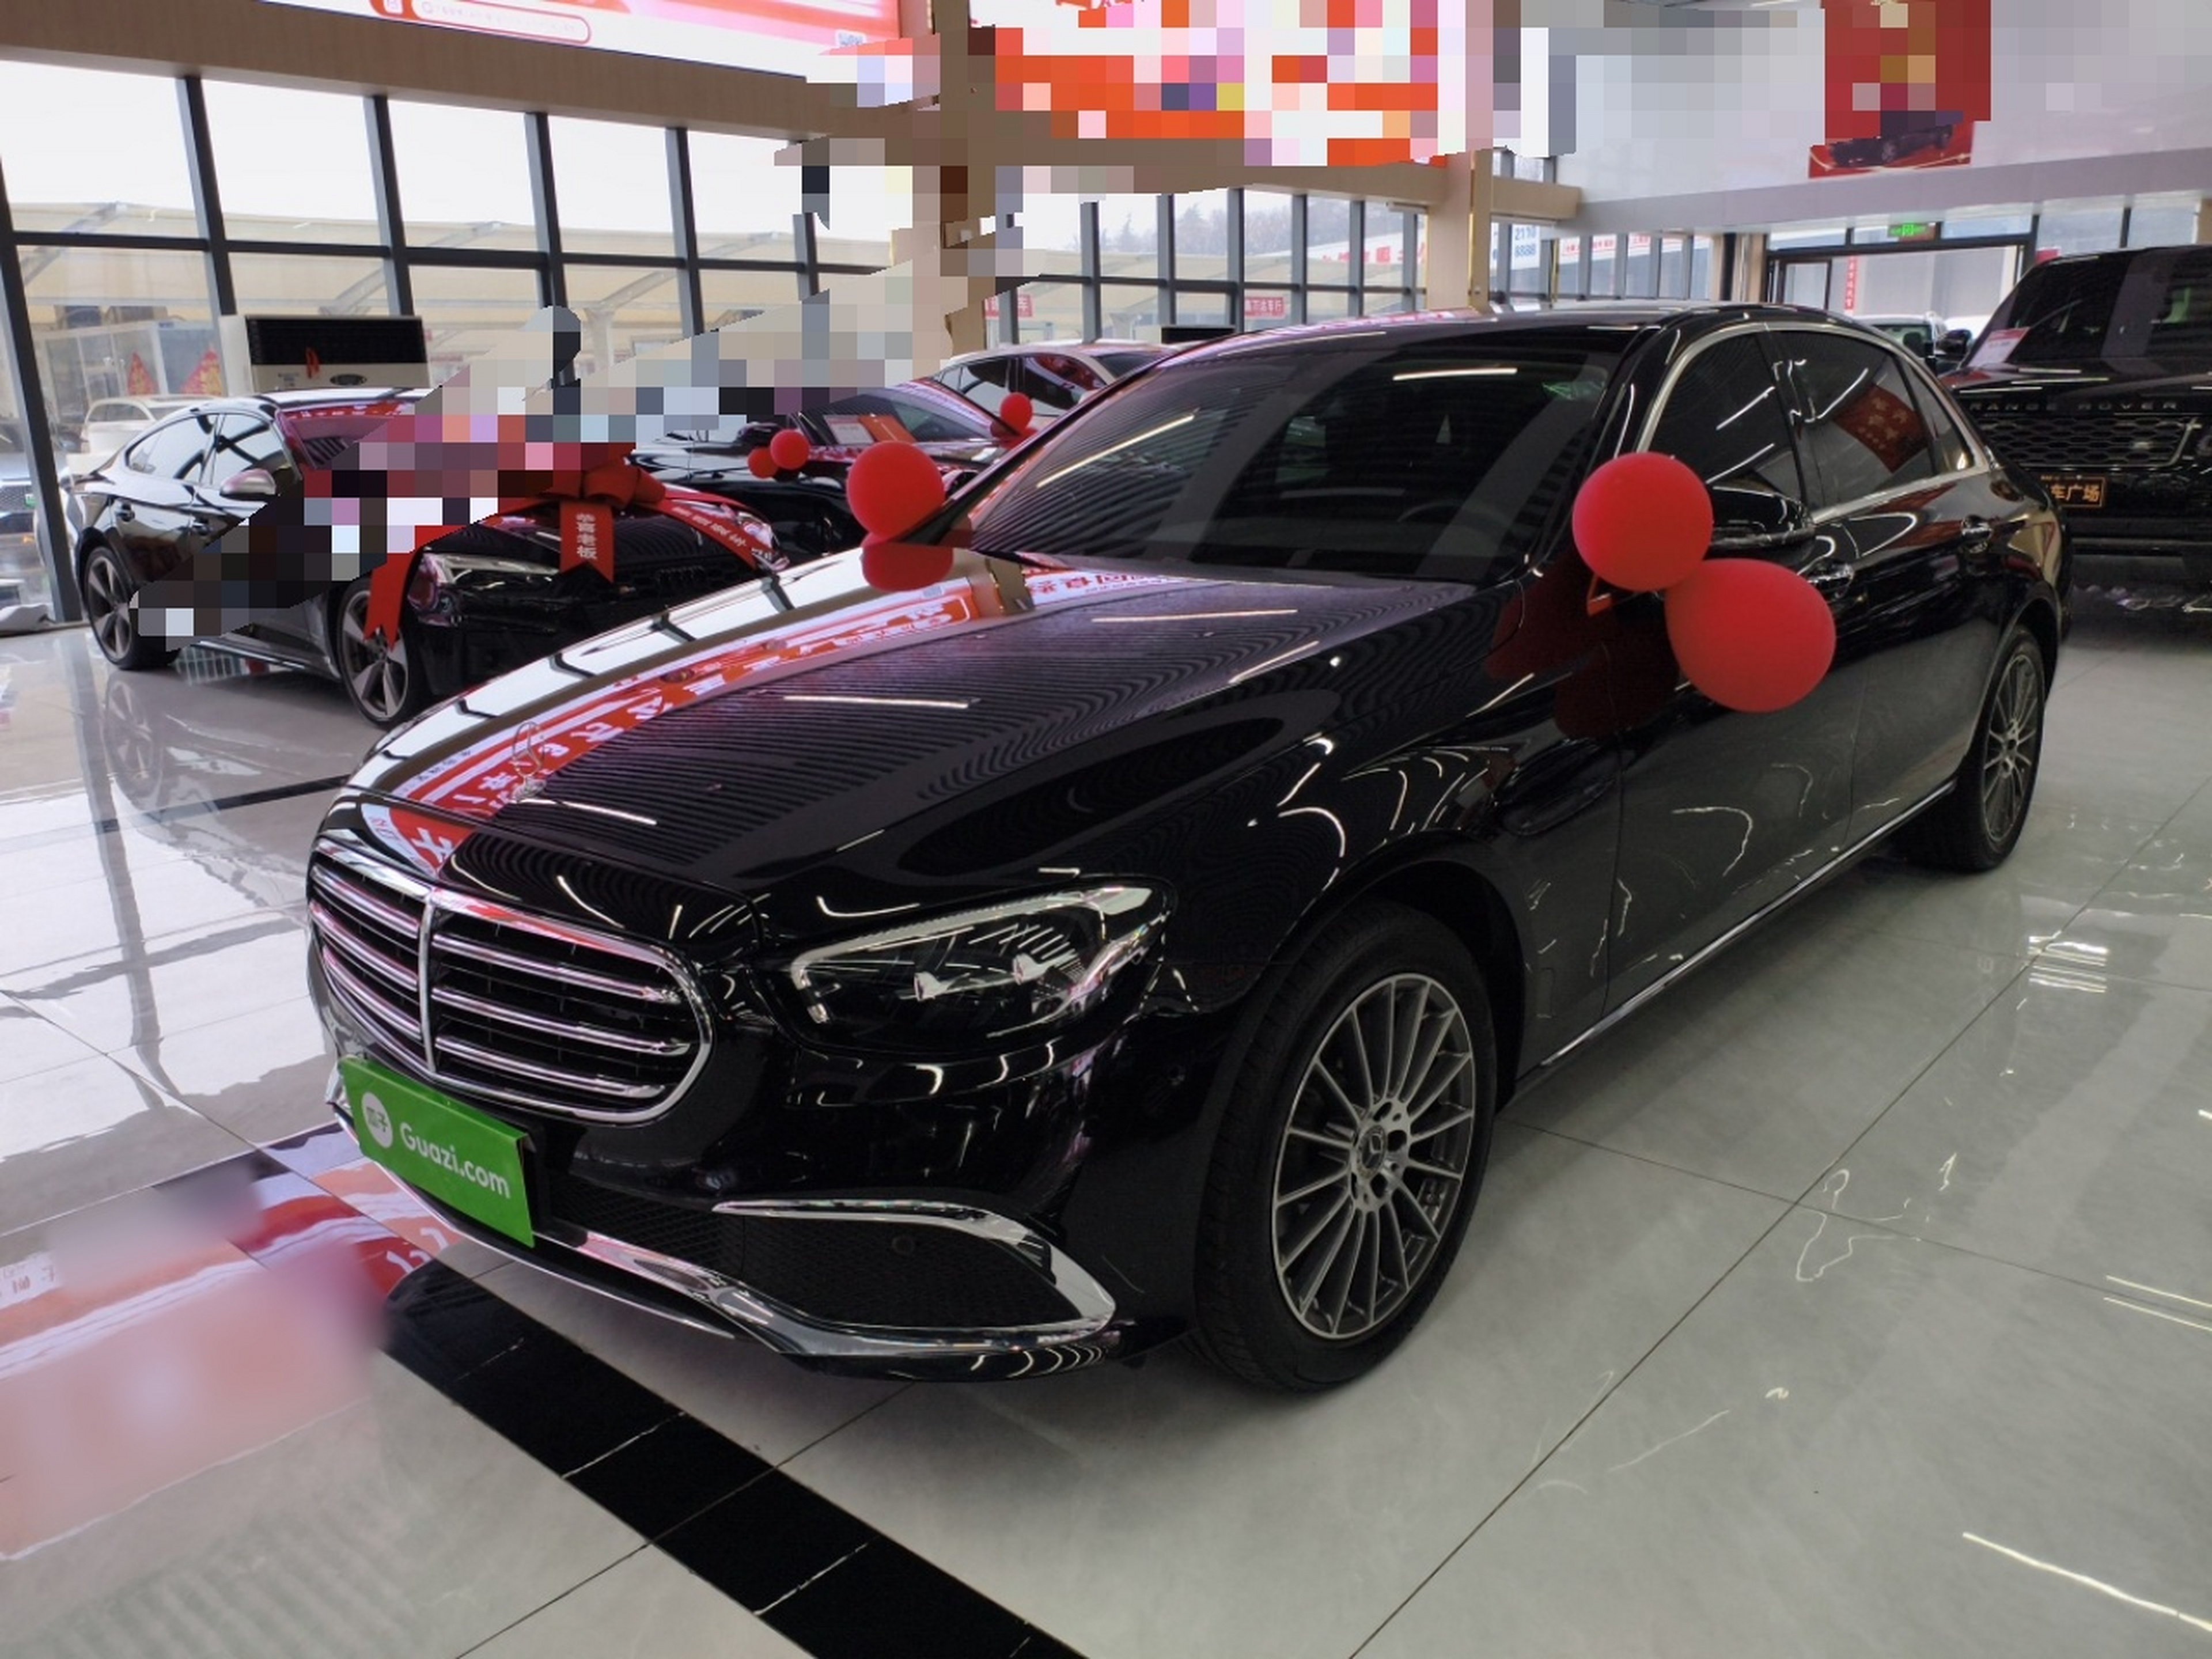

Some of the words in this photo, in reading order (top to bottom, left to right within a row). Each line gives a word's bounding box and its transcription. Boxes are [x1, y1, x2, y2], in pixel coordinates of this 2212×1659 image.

[1969, 402, 2058, 411] RANGE
[2077, 402, 2179, 411] ROVER
[2046, 483, 2101, 502] 车广场
[399, 1121, 512, 1200] Guazi.com
